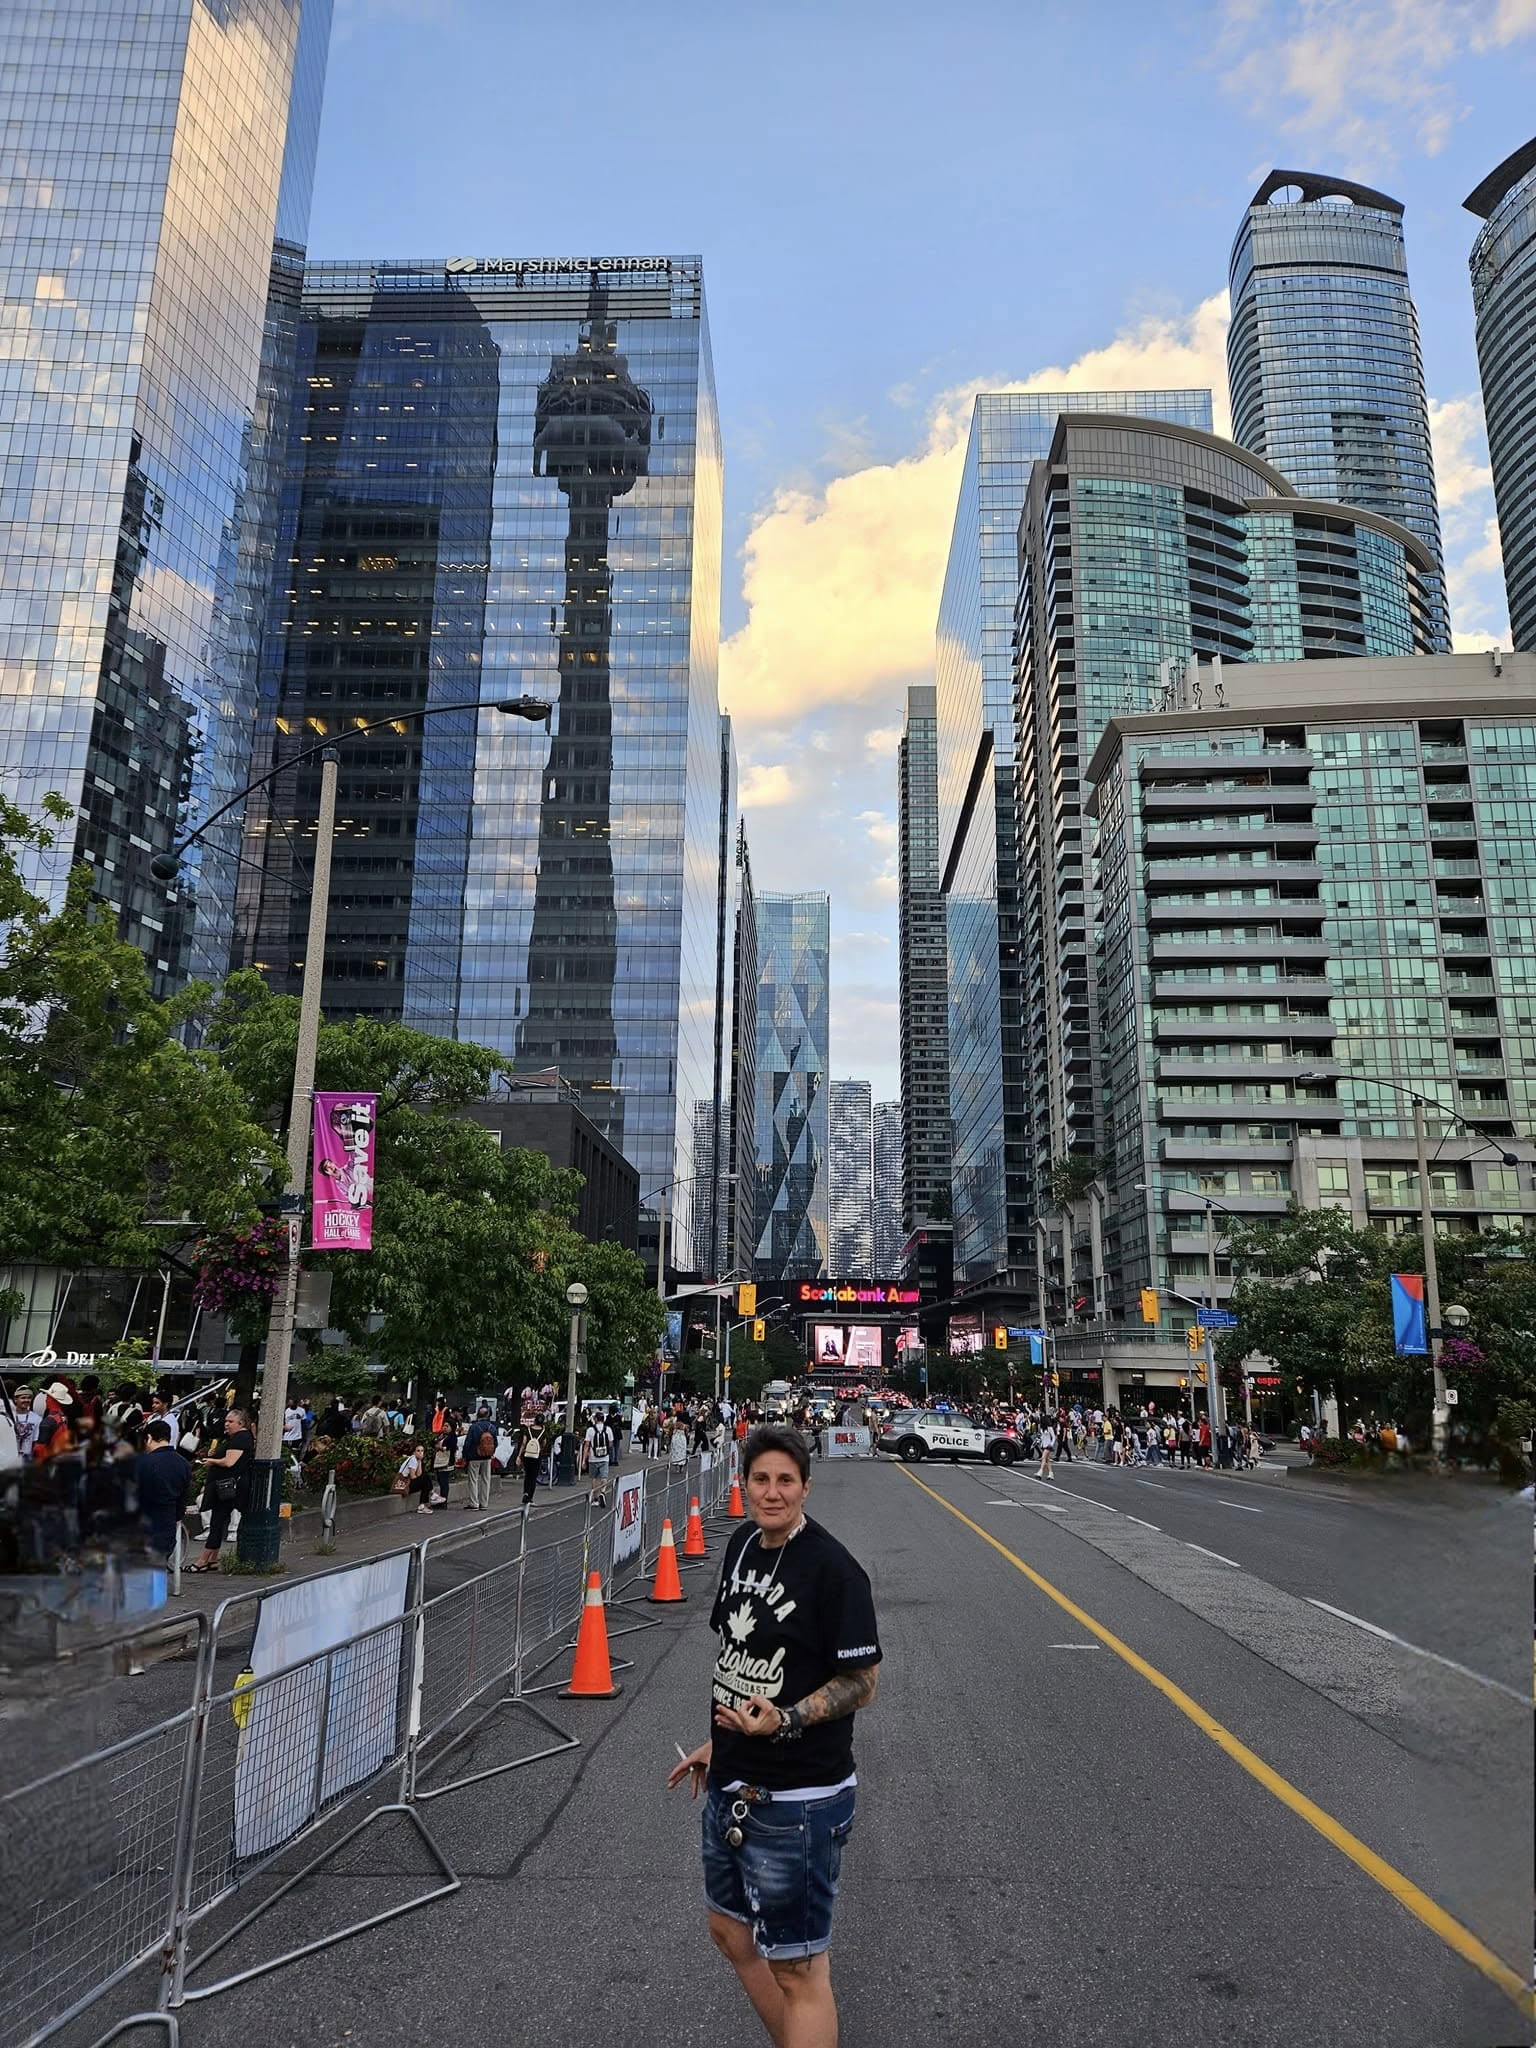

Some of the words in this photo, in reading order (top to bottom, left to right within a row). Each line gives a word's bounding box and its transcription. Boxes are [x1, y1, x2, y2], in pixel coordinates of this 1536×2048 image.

[351, 1102, 371, 1124] it
[348, 1129, 370, 1206] Save
[324, 1213, 360, 1227] HOCKEY
[324, 1228, 340, 1238] HALL
[801, 1284, 885, 1302] Scotiabank
[932, 1436, 969, 1447] POLICE
[719, 1624, 786, 1684] iginal
[837, 1645, 877, 1659] KINGSTON
